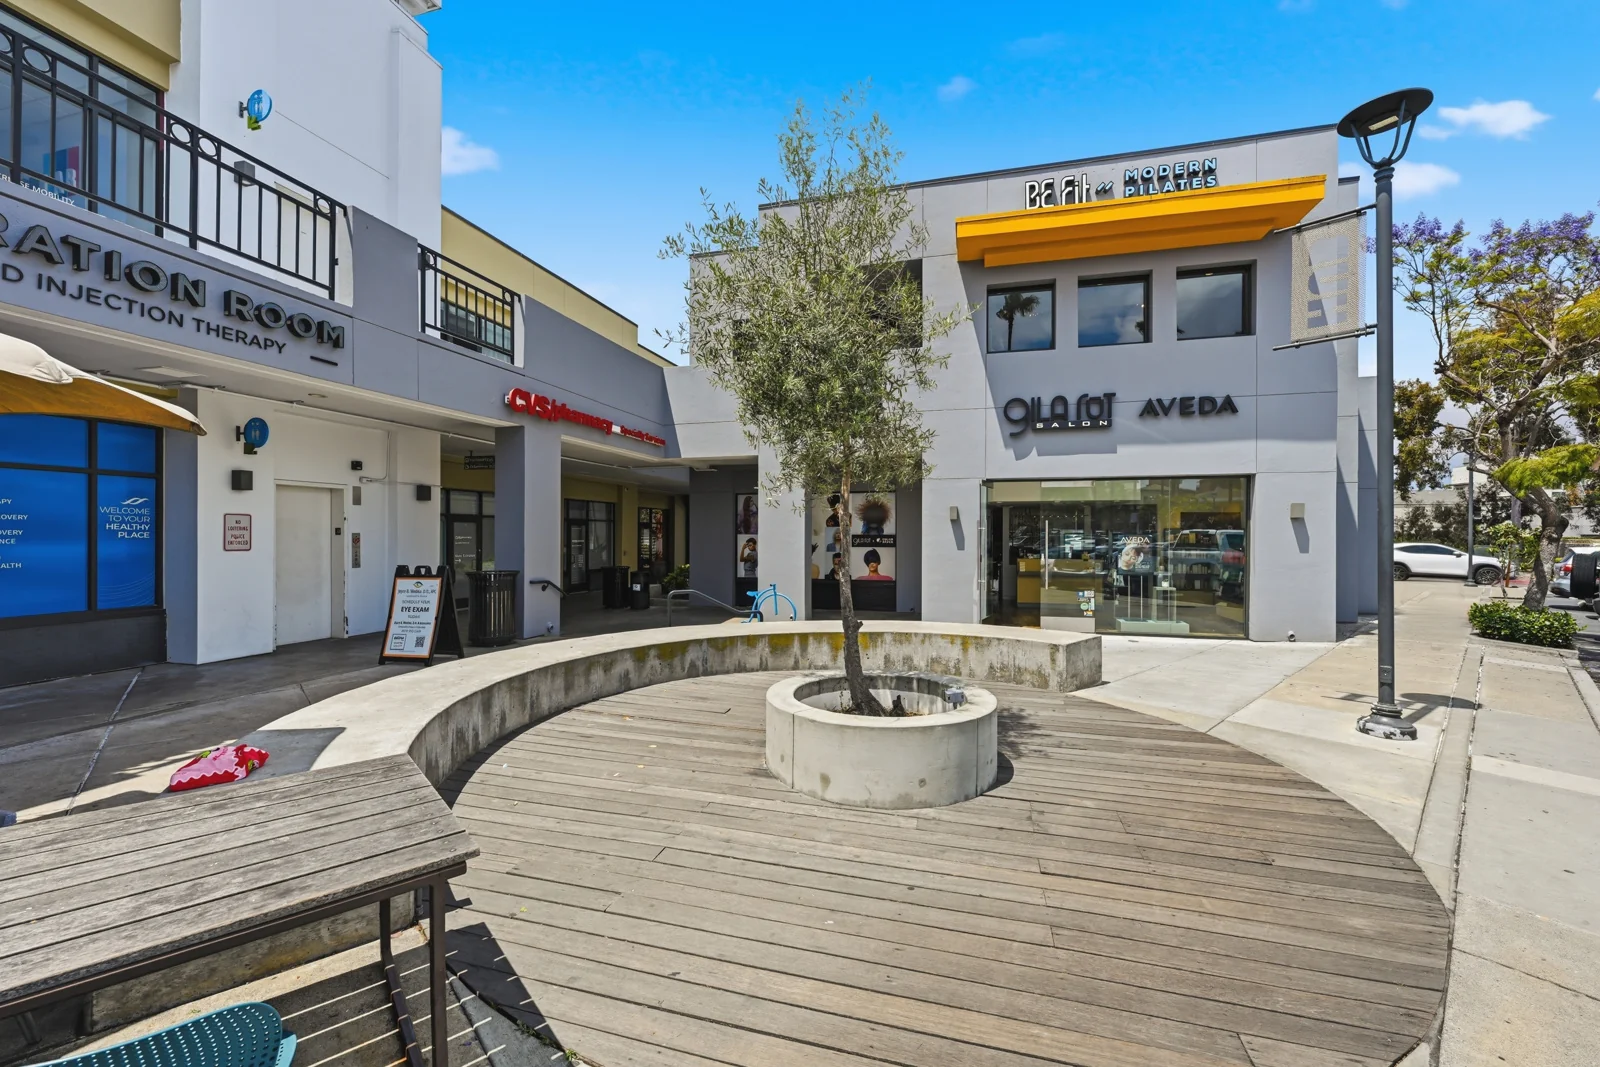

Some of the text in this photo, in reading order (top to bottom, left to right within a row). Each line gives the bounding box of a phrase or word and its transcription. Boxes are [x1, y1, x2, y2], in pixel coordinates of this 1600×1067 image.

[1123, 158, 1217, 182] MODERN
[32, 185, 75, 206] MOBILITY
[1025, 179, 1055, 210] BE
[1123, 175, 1217, 198] PILATES
[37, 273, 184, 328] INJECTION
[192, 317, 286, 354] THERAPY
[223, 289, 345, 348] ROOM
[1139, 394, 1239, 417] AVEDA
[1036, 420, 1109, 429] SALON
[99, 506, 151, 515] WELCOME
[108, 514, 122, 522] TO
[118, 531, 150, 539] PLACE
